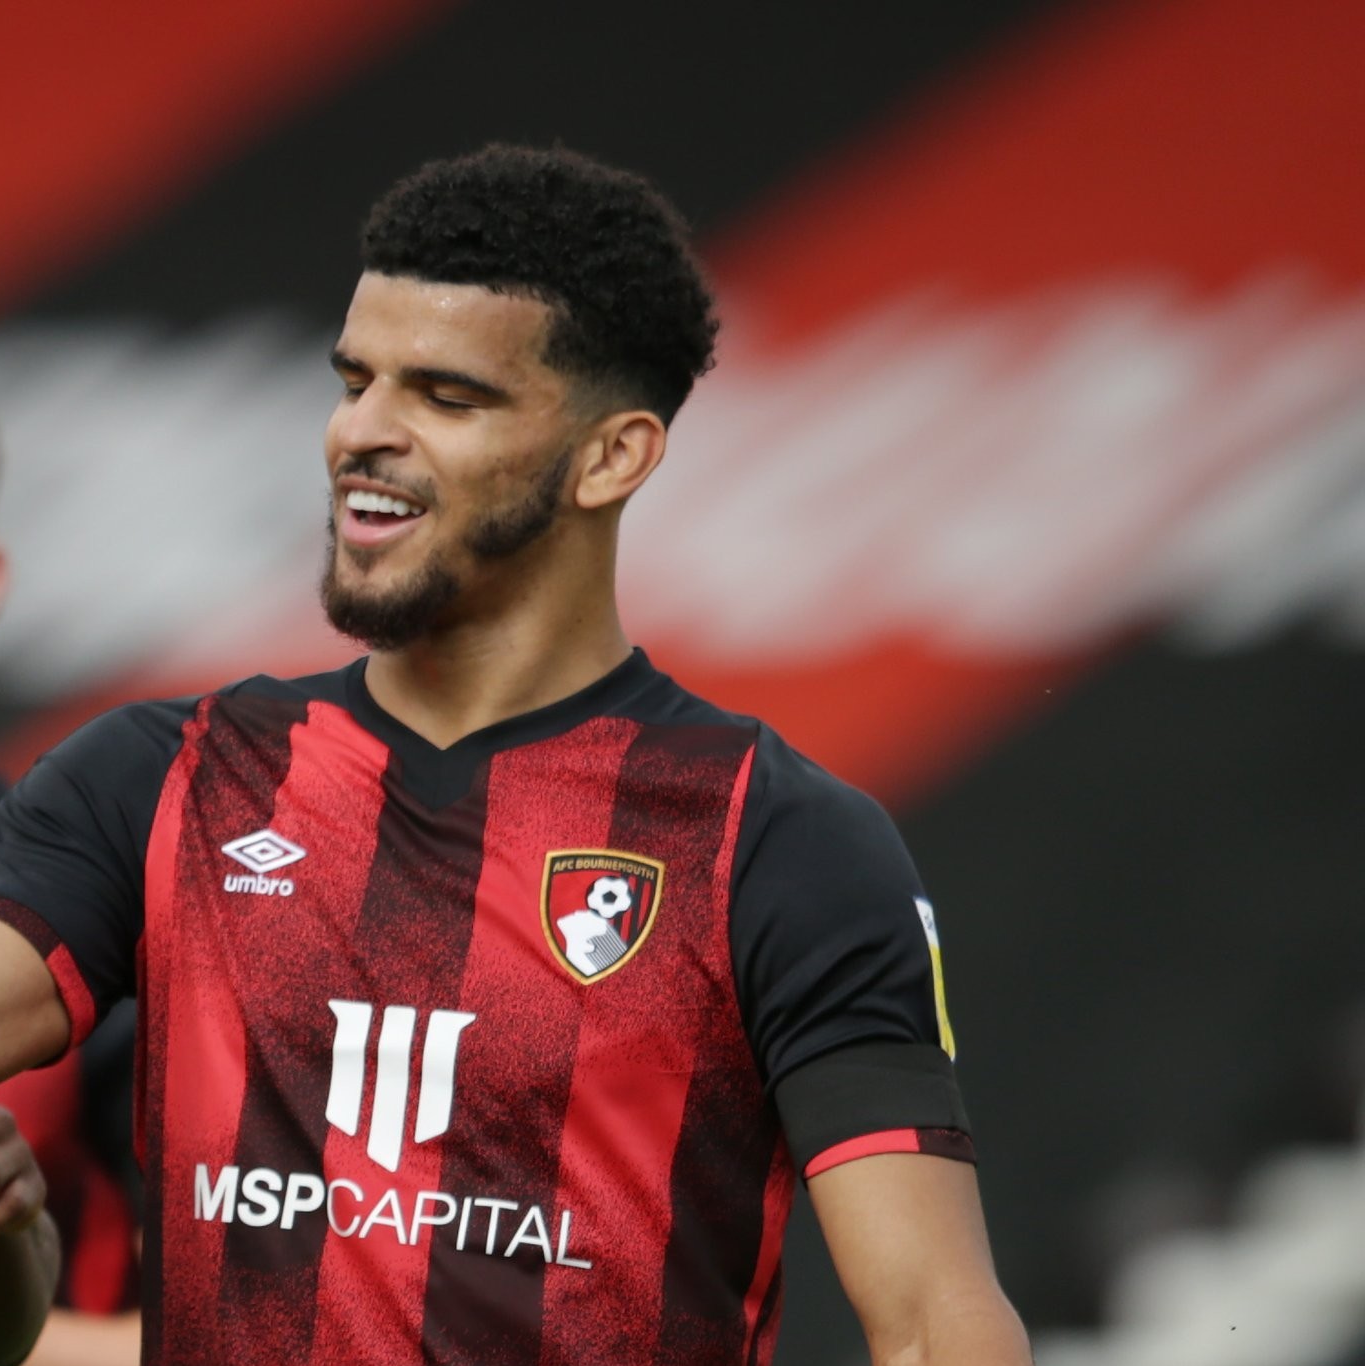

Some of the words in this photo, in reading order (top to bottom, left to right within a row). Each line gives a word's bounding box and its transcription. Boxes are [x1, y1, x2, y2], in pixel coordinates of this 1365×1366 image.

[552, 859, 574, 873] AFC
[575, 858, 655, 880] BOURNEMOUTH
[224, 873, 294, 897] umbro
